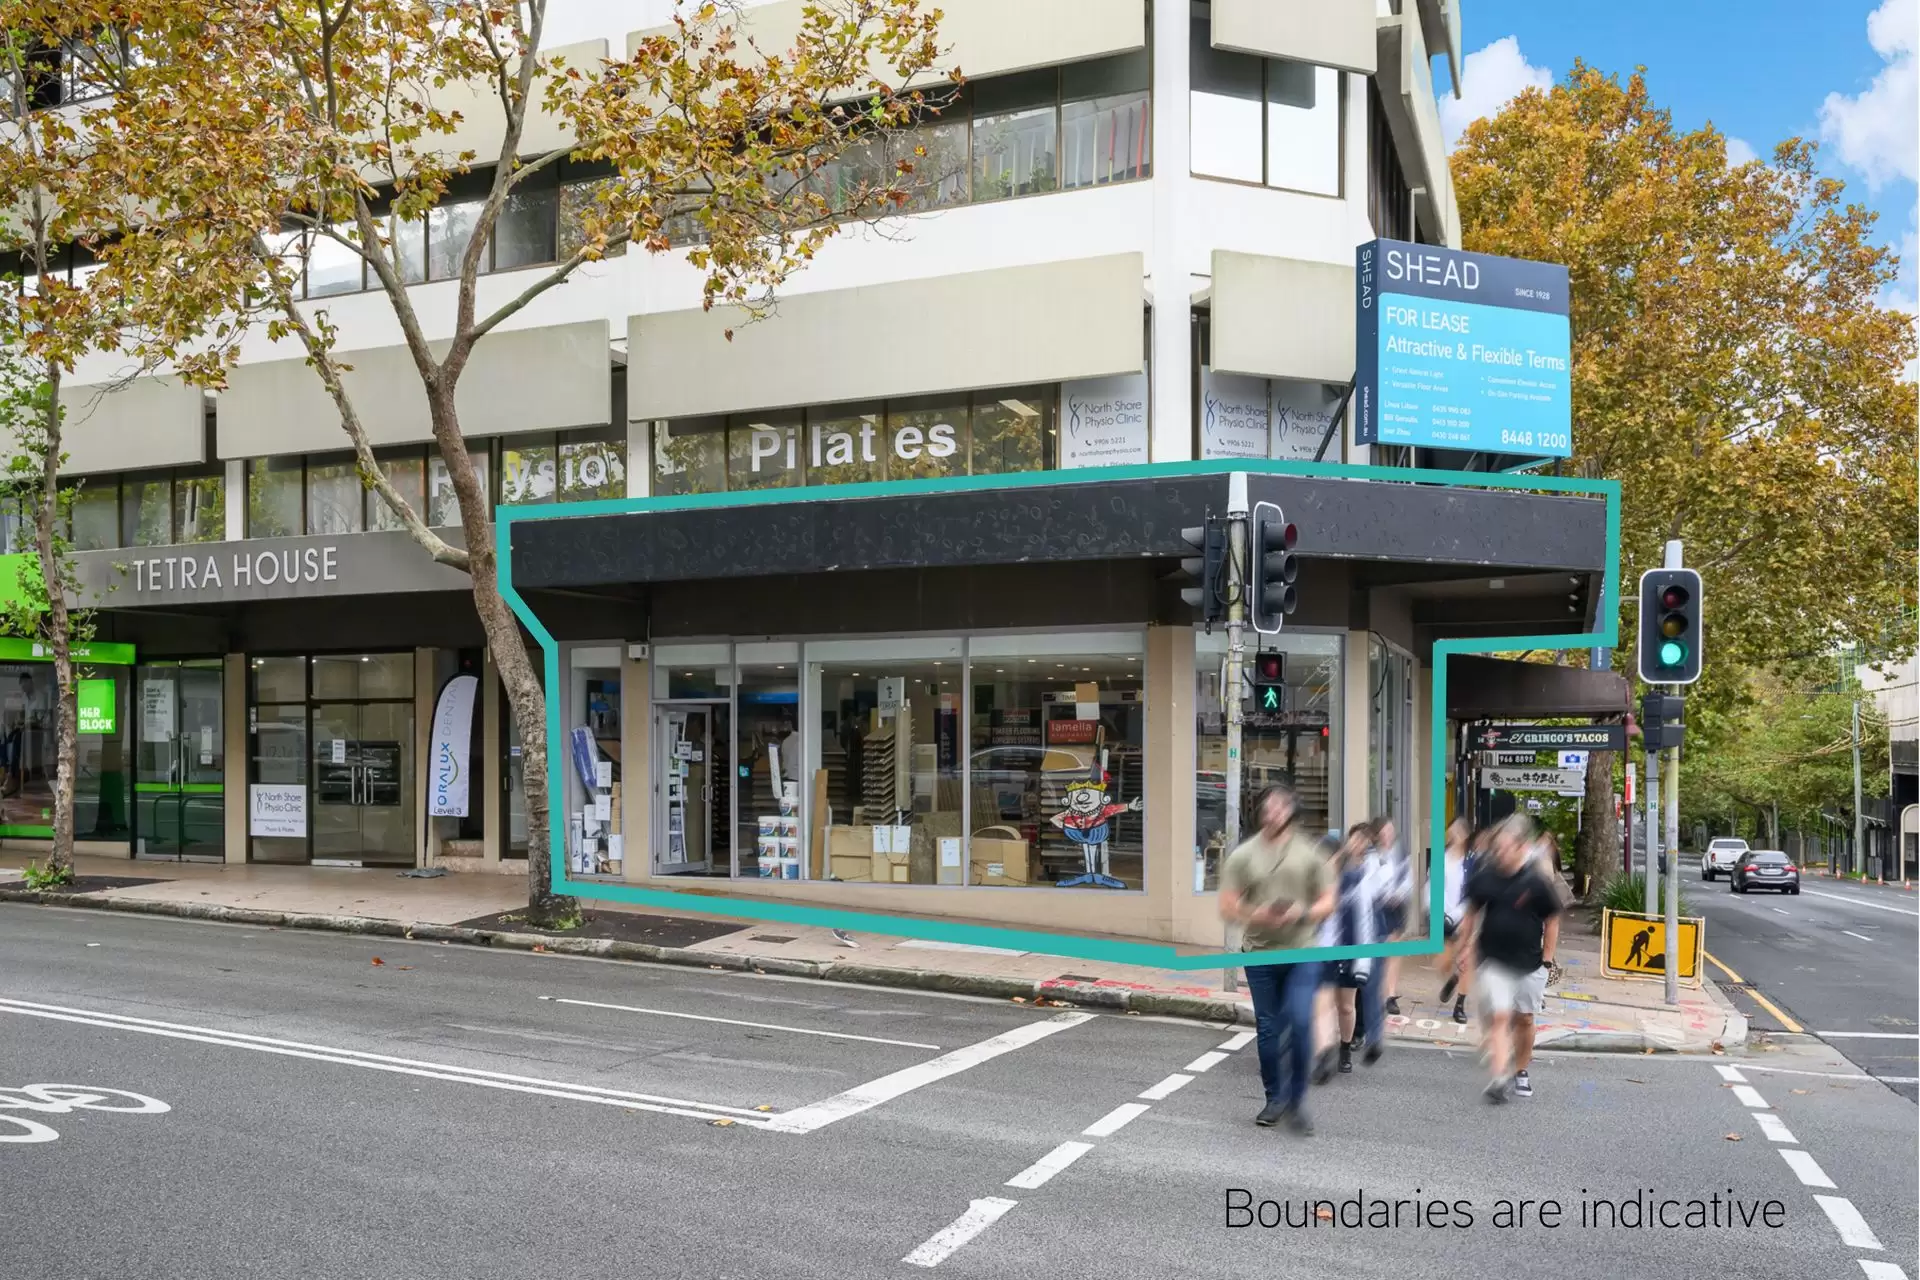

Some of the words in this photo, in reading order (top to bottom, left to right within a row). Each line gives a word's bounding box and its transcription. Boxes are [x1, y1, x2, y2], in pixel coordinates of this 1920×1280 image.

[1387, 250, 1480, 290] SHEAD
[1362, 249, 1372, 309] SHEAD
[1515, 288, 1534, 298] SINCE
[1536, 290, 1551, 300] 1928
[1386, 306, 1418, 327] FOR
[1422, 310, 1470, 334] LEASE
[1386, 335, 1452, 359] Attractive
[1457, 342, 1467, 360] &
[1472, 344, 1523, 366] Flexible
[1525, 349, 1566, 371] Terms
[1085, 402, 1112, 414] North
[1114, 400, 1142, 412] Shore
[1218, 402, 1243, 414] North
[1244, 404, 1268, 417] Shore
[1085, 416, 1114, 428] Physio
[1115, 413, 1142, 425] Clinic
[1291, 409, 1314, 421] North
[1218, 415, 1244, 430] Physio
[1291, 422, 1316, 436] Physio
[1502, 428, 1533, 446] 8448
[1537, 431, 1567, 448] 1200
[751, 423, 957, 472] Pilates
[133, 555, 222, 591] TETRA
[234, 546, 337, 587] HOUSE
[80, 707, 101, 718] H&R
[80, 719, 112, 730] BLOCK
[1051, 722, 1093, 732] lamella
[1509, 733, 1524, 744] El
[1524, 733, 1573, 743] GRINGO'S
[1574, 733, 1609, 743] TACOS
[437, 742, 452, 806] ORALUX
[264, 791, 282, 801] North
[284, 792, 302, 802] Shore
[264, 803, 284, 813] Physio
[284, 802, 301, 812] Clinic
[433, 807, 455, 815] Level
[456, 807, 462, 815] 3
